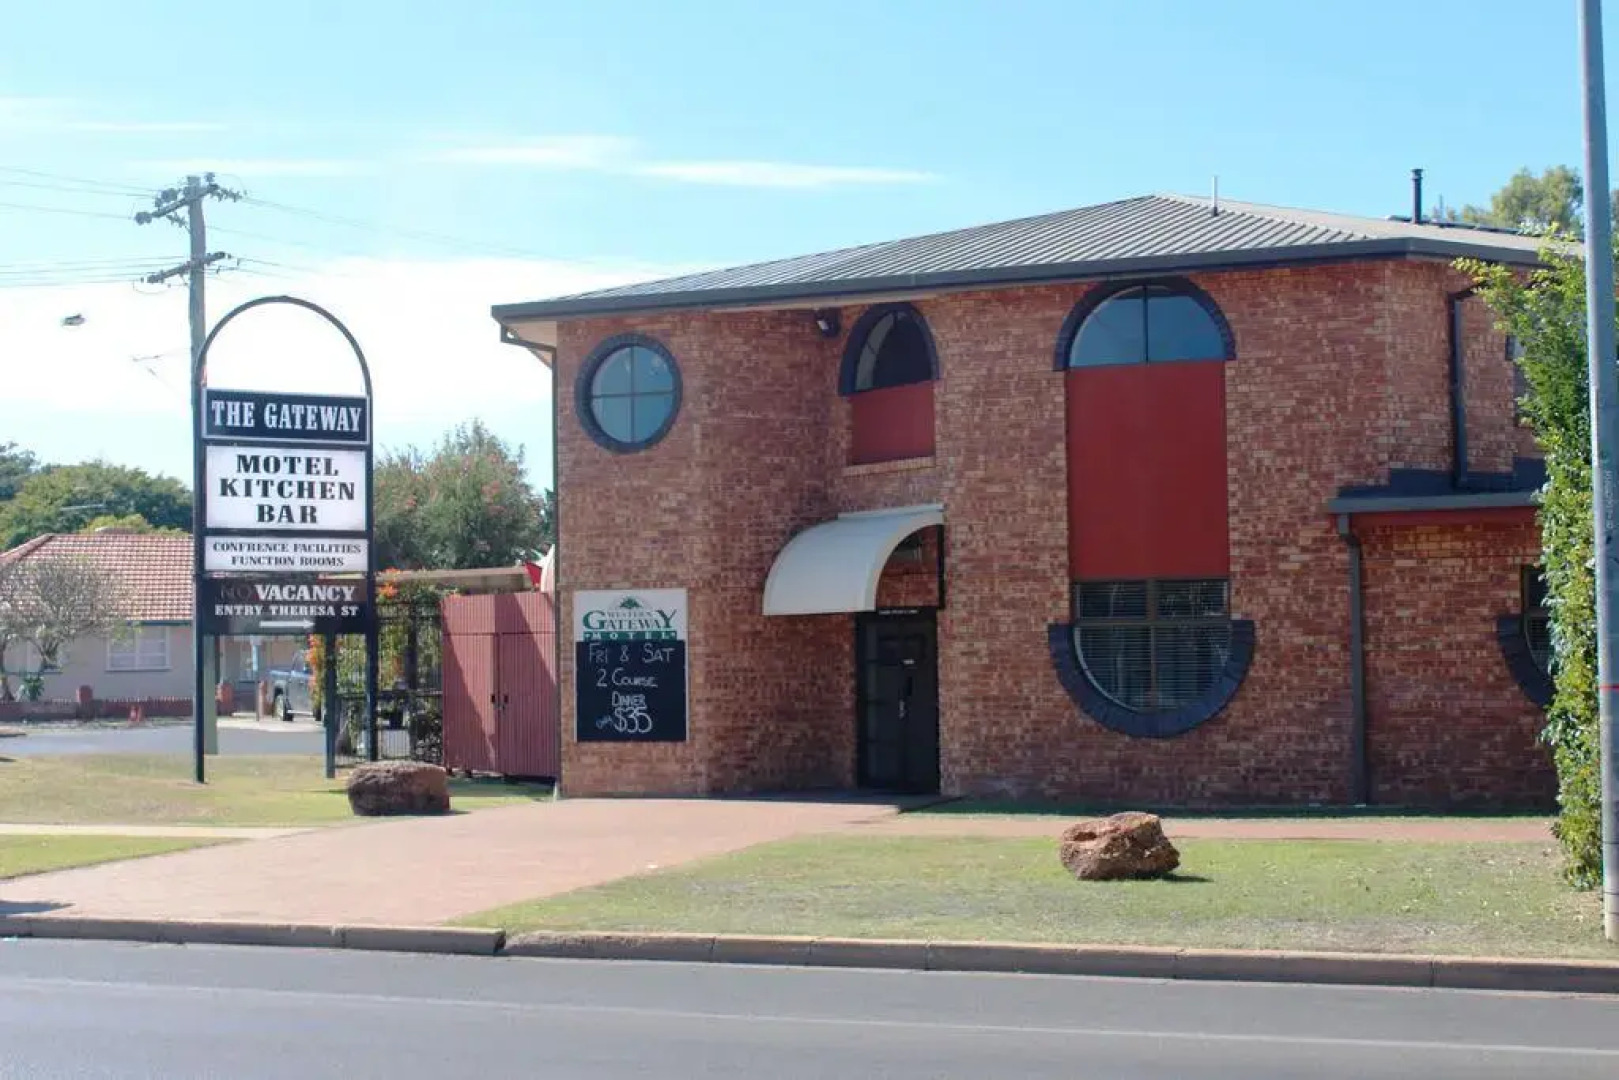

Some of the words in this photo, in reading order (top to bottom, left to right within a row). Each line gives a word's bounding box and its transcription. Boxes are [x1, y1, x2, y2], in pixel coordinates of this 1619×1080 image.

[211, 400, 254, 428] THE
[264, 403, 361, 432] GATEWAY
[236, 455, 338, 476] MOTEL
[220, 479, 355, 500] KITCHEN
[257, 504, 318, 524] BAR
[213, 542, 289, 553] CONFRENCE
[293, 543, 361, 553] FACILITIES
[231, 556, 295, 566] FUNCTION
[300, 557, 344, 566] ROOMS
[221, 584, 252, 599] NO
[255, 585, 355, 601] VACANCY
[215, 604, 263, 616] ENTRY
[269, 605, 335, 616] THERESA
[341, 606, 359, 616] ST
[583, 609, 677, 630] GATEWAY
[620, 645, 630, 662] &
[642, 643, 675, 663] SAT
[596, 669, 607, 687] 2
[614, 707, 652, 733] $35
